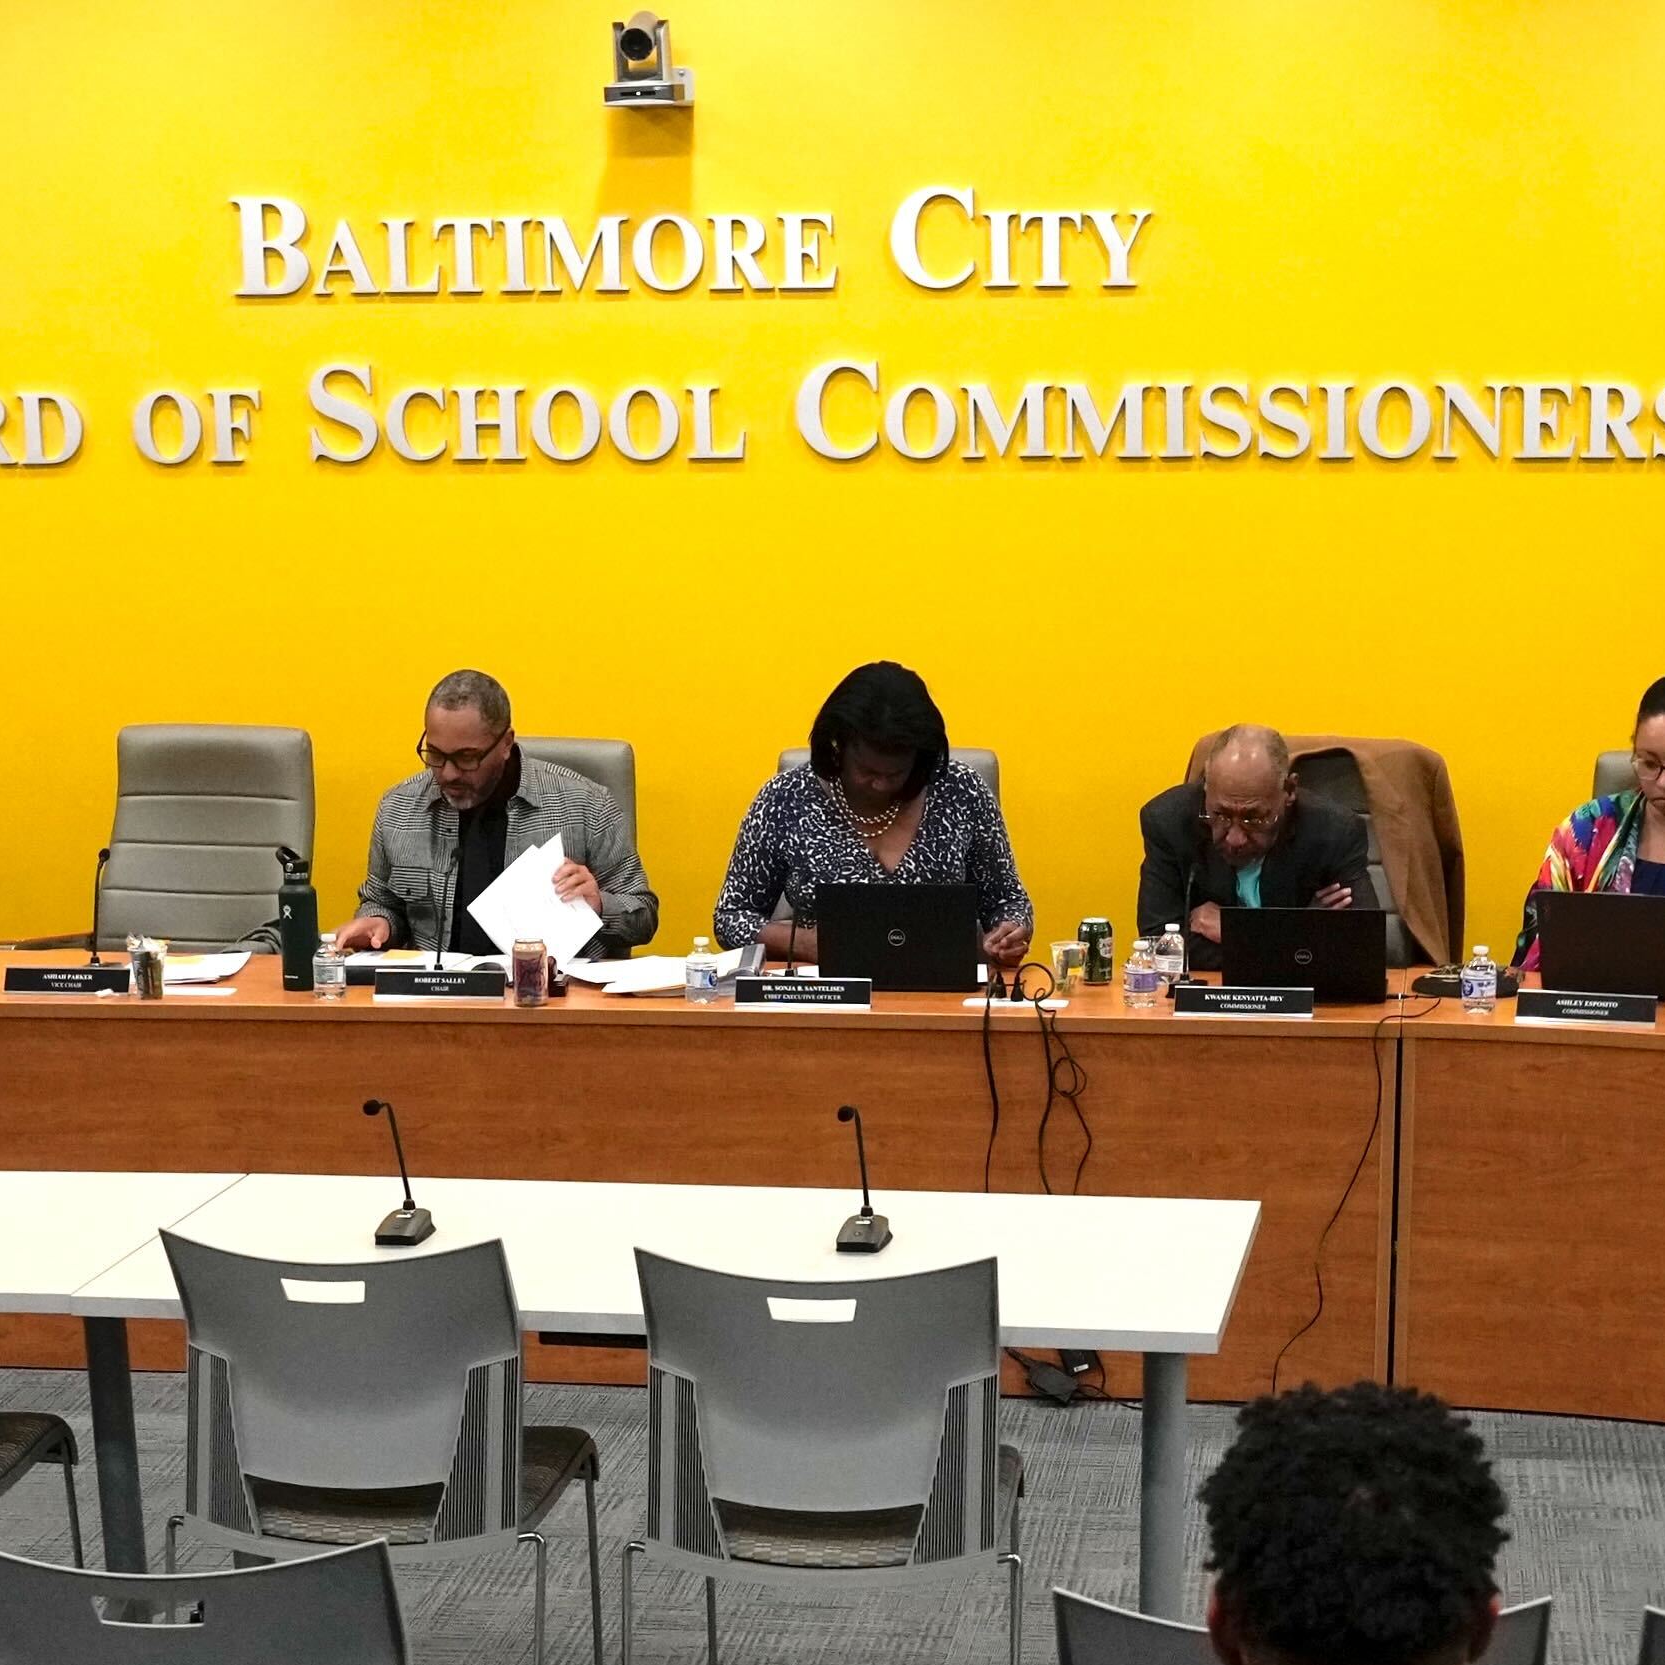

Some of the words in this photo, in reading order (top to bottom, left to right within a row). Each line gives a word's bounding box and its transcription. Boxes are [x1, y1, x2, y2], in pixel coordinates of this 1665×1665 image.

[230, 198, 839, 297] BALTIMORE
[890, 185, 1152, 290] CITY
[133, 390, 262, 465] OF
[308, 363, 747, 463] SCHOOL
